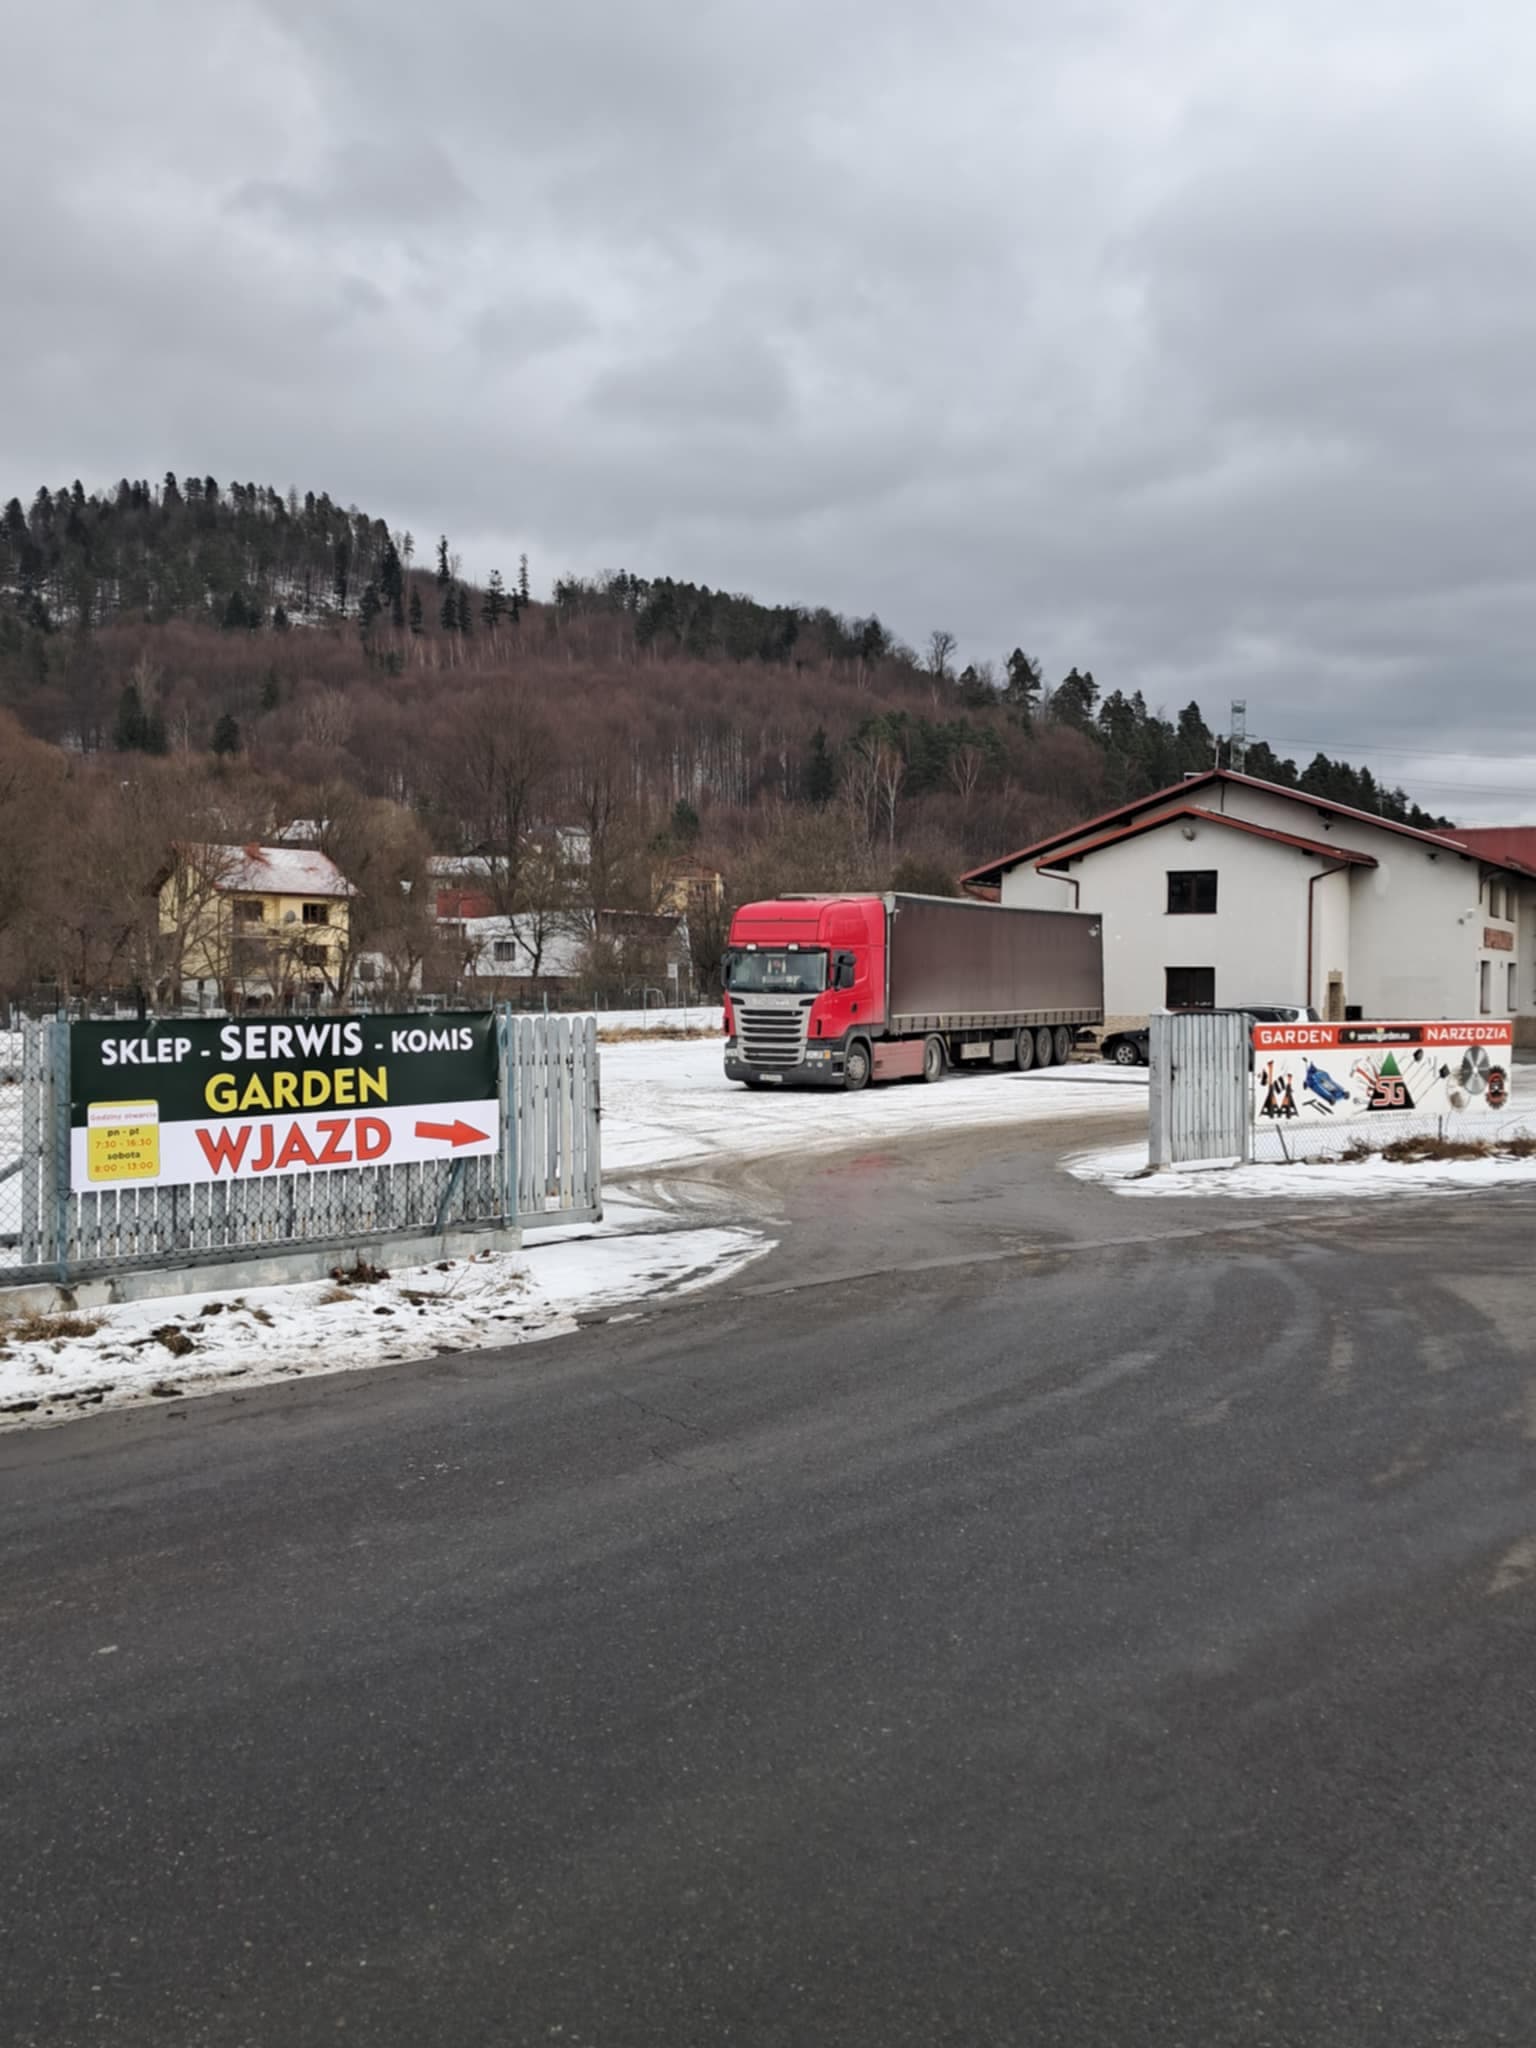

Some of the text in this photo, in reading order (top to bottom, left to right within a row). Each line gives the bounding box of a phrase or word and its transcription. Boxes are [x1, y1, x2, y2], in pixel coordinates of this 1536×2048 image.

[101, 1037, 192, 1066] SKLEP
[220, 1022, 363, 1062] SERWIS
[391, 1027, 474, 1053] KOMIS
[1260, 1029, 1333, 1045] GARDEN
[1426, 1027, 1509, 1042] NARZĘDZIA
[204, 1065, 389, 1113] GARDEN
[107, 1129, 120, 1137] pn
[129, 1127, 139, 1136] pt
[195, 1116, 392, 1176] WJAZD
[107, 1151, 141, 1160] sobota
